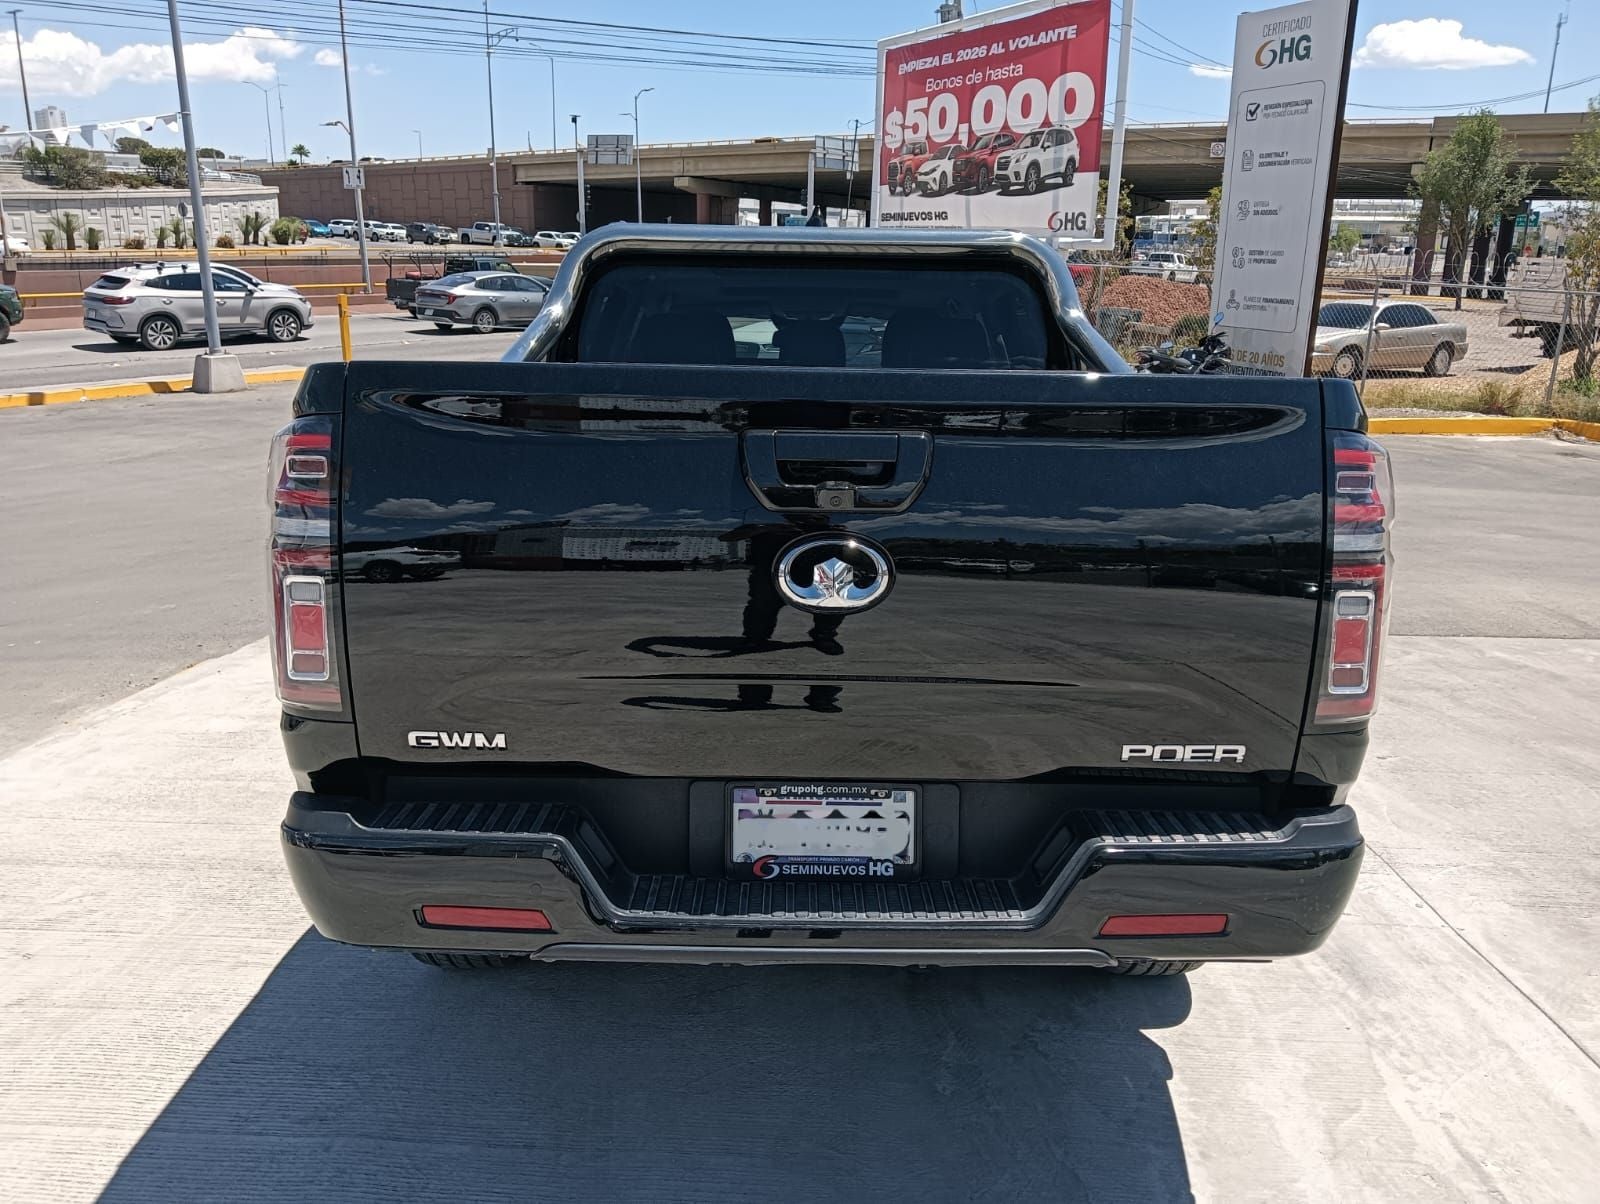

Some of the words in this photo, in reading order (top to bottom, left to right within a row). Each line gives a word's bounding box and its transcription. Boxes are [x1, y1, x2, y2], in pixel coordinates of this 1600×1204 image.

[1262, 15, 1312, 38] CERTIFICADO
[898, 55, 939, 75] EMPIEZA
[941, 52, 954, 66] EL
[956, 45, 987, 62] 2026
[988, 42, 1005, 56] AL
[1008, 25, 1077, 51] VOLANTE
[1278, 34, 1312, 64] HG
[925, 74, 962, 93] Bonos
[965, 69, 982, 85] de
[985, 62, 1023, 82] hasta
[884, 71, 1095, 153] $50,000
[881, 211, 934, 222] SEMINUEVOS
[934, 211, 949, 221] HG
[1064, 211, 1087, 231] HG
[1236, 349, 1248, 362] DE
[1249, 351, 1260, 365] 20
[1260, 351, 1285, 368] AÑOS
[407, 731, 507, 748] GWM
[1120, 744, 1247, 763] POER
[780, 784, 867, 795] grupohg.com.mx
[782, 865, 866, 876] SEMINUEVOS
[868, 861, 894, 876] HG
